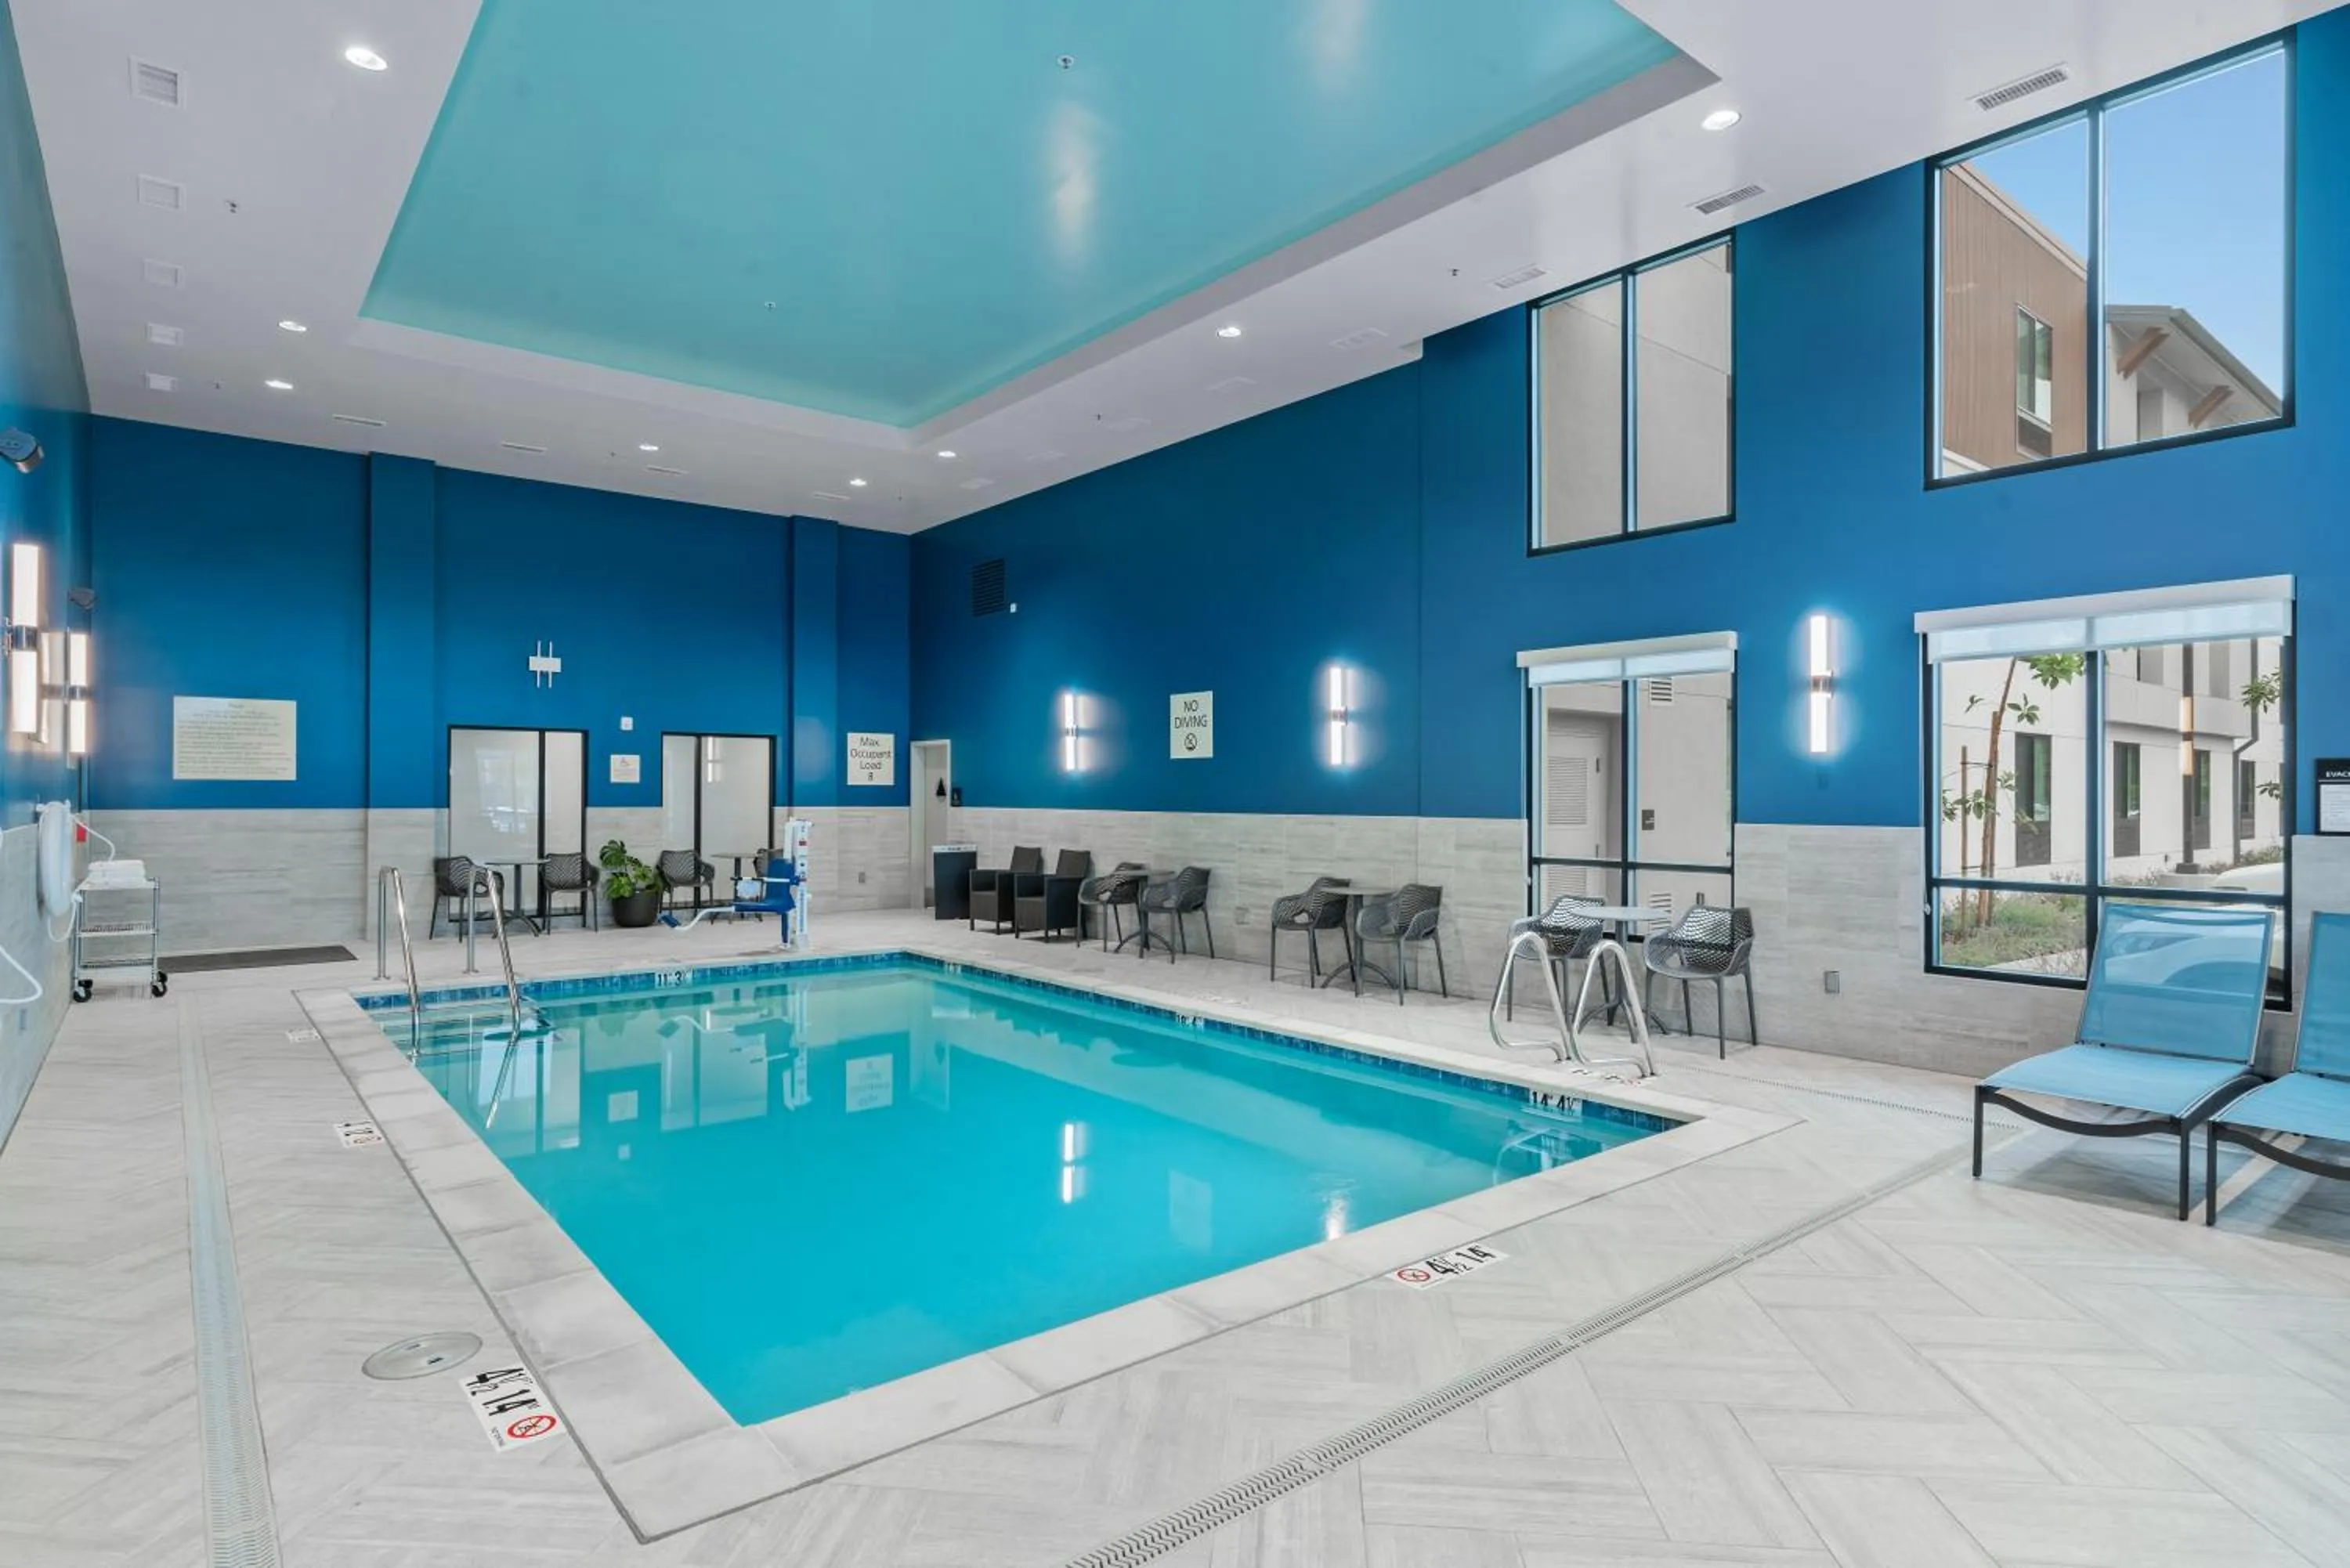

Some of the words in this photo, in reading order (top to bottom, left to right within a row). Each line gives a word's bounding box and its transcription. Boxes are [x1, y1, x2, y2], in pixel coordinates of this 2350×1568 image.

[1183, 699, 1198, 712] NO
[1174, 715, 1207, 728] DIVING
[859, 761, 882, 770] Load
